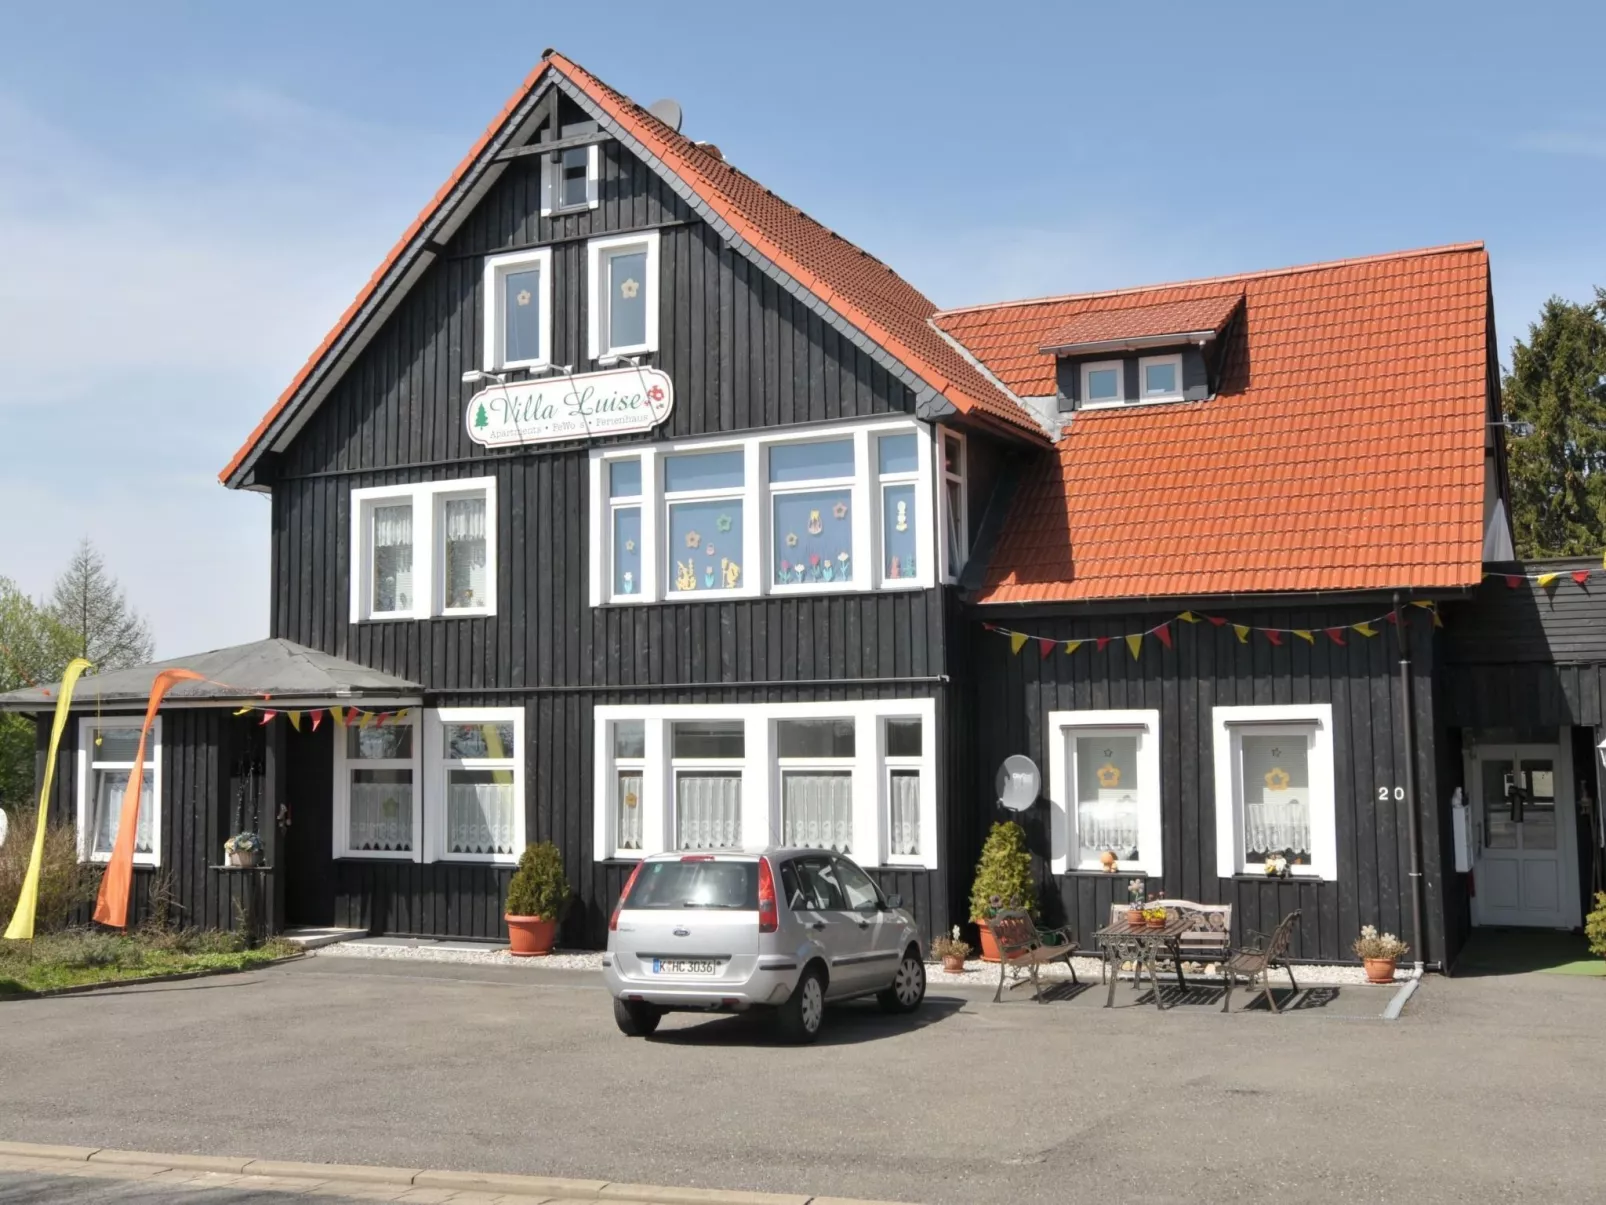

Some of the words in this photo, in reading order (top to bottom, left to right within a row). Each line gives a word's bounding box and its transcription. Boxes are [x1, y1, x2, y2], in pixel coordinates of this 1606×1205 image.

[490, 393, 558, 425] Villa
[563, 386, 643, 416] Luise
[489, 426, 542, 439] Apartments
[595, 415, 649, 427] Ferienhaus
[1378, 786, 1405, 801] 20
[687, 961, 713, 973] 3036
